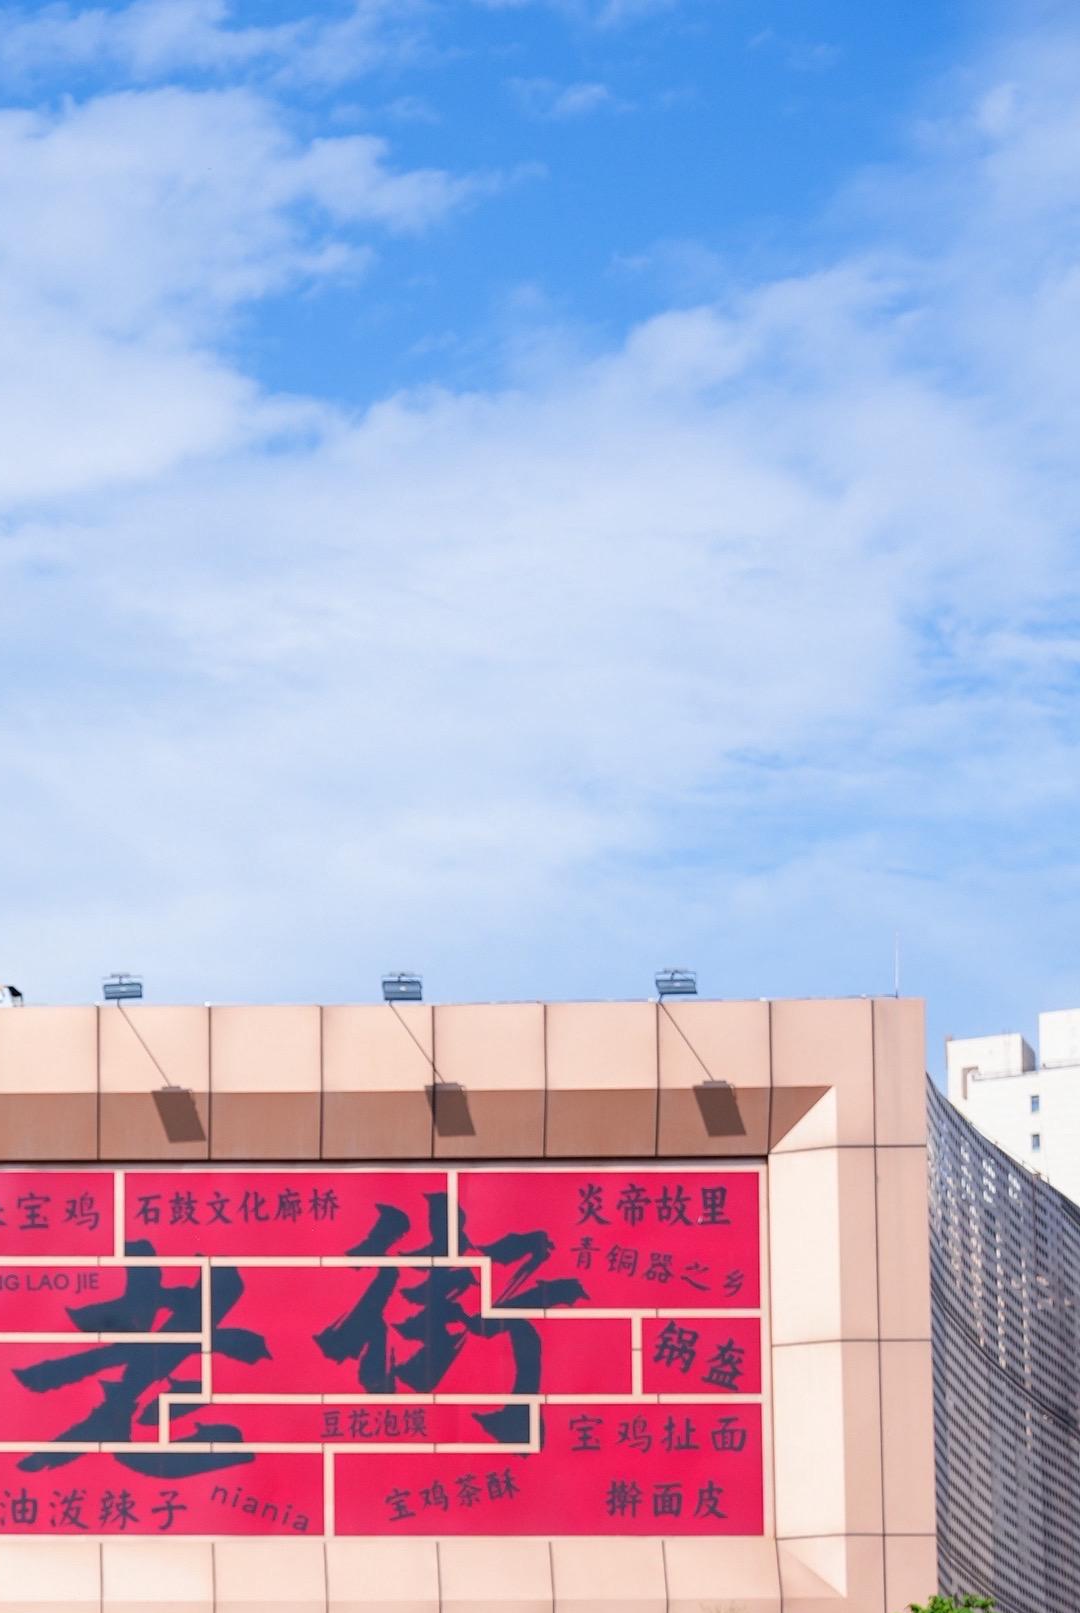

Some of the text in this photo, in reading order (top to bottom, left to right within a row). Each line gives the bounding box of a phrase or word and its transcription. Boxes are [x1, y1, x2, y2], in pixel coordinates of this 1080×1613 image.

[134, 1190, 339, 1226] 石鼓文化廊桥
[576, 1183, 731, 1228] 炎帝故里
[26, 1273, 70, 1293] LAO
[75, 1273, 100, 1294] JIE
[570, 1236, 745, 1297] 青铜器之乡
[653, 1319, 745, 1391] 锅盔
[320, 1408, 428, 1438] 豆花泡馍
[569, 1414, 747, 1453] 宝鸡扯面
[0, 1487, 187, 1530] 油泼辣子
[210, 1486, 310, 1531] niania
[384, 1468, 521, 1521] 宝鸡茶酥
[606, 1480, 728, 1519] 擀面皮
